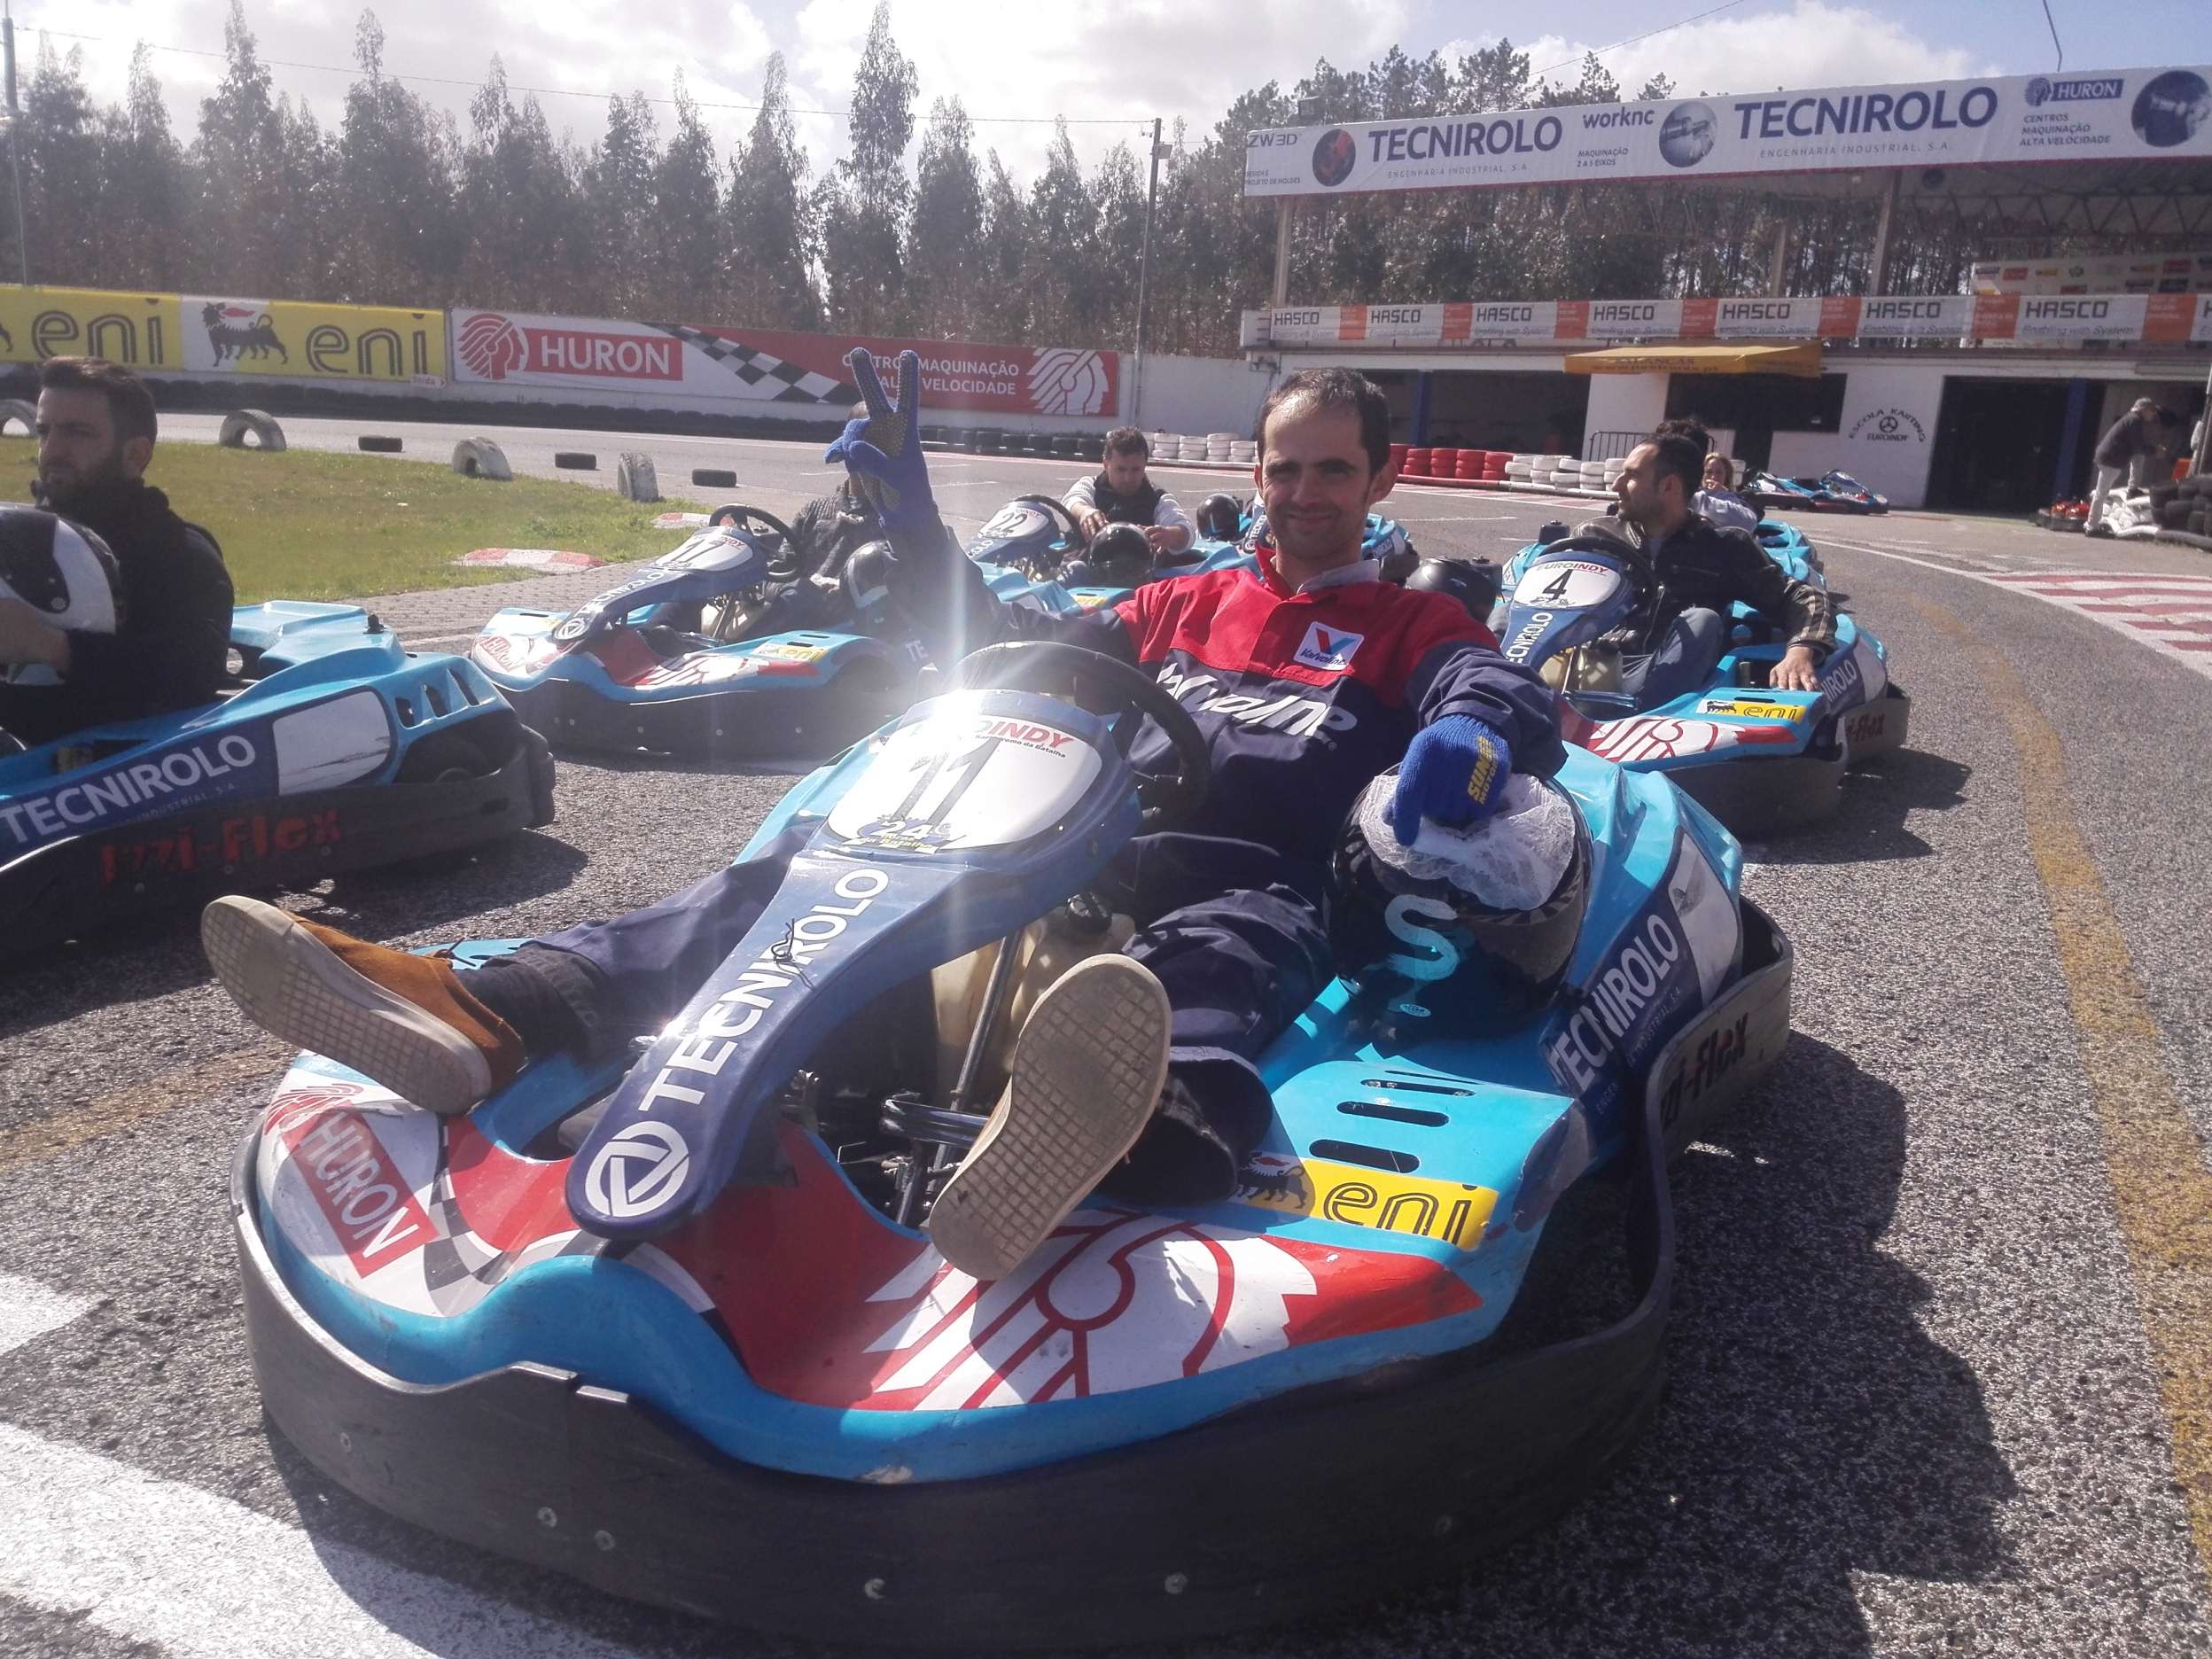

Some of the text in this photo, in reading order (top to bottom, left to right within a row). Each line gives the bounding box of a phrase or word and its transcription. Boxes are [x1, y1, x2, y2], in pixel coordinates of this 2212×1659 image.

[2058, 82, 2117, 98] HURON
[1583, 106, 1655, 129] worknc
[1734, 87, 1998, 139] TECNIROLO
[2023, 113, 2069, 123] CENTROS
[2021, 123, 2091, 135] MAQUINAÇÃO
[1367, 116, 1563, 162] TECNIROLO
[2047, 136, 2111, 145] VELOCIDADE
[1578, 147, 1629, 158] MAQUINAÇÃO
[1760, 145, 1836, 158] ENGENHARIA
[1388, 168, 1445, 178] ENGENHARIA
[1274, 311, 1320, 325] HASCO
[1371, 309, 1421, 323] HASCO
[1476, 307, 1531, 322] HASCO
[1593, 306, 1655, 321] HASCO
[1722, 304, 1790, 320] HASCO
[1866, 302, 1941, 318] HASCO
[2026, 300, 2108, 318] HASCO
[31, 297, 164, 365] eni
[306, 312, 428, 376] eni
[541, 336, 670, 375] HURON
[918, 359, 1019, 378] MAQUINAÇÃO
[923, 378, 1016, 395] VELOCIDADE
[1849, 409, 1926, 442] ESCOLA KARTING
[988, 512, 1028, 532] 22
[1537, 563, 1608, 573] EUROINDY
[1542, 569, 1572, 603] 4
[1743, 705, 1799, 720] eni
[0, 735, 256, 845] TECNIROLO
[909, 736, 1001, 828] 11
[639, 868, 889, 1112] TECNIROLO
[1549, 914, 1678, 1093] TECNIROLO
[298, 1110, 419, 1258] HURON
[1322, 1183, 1479, 1248] eni
